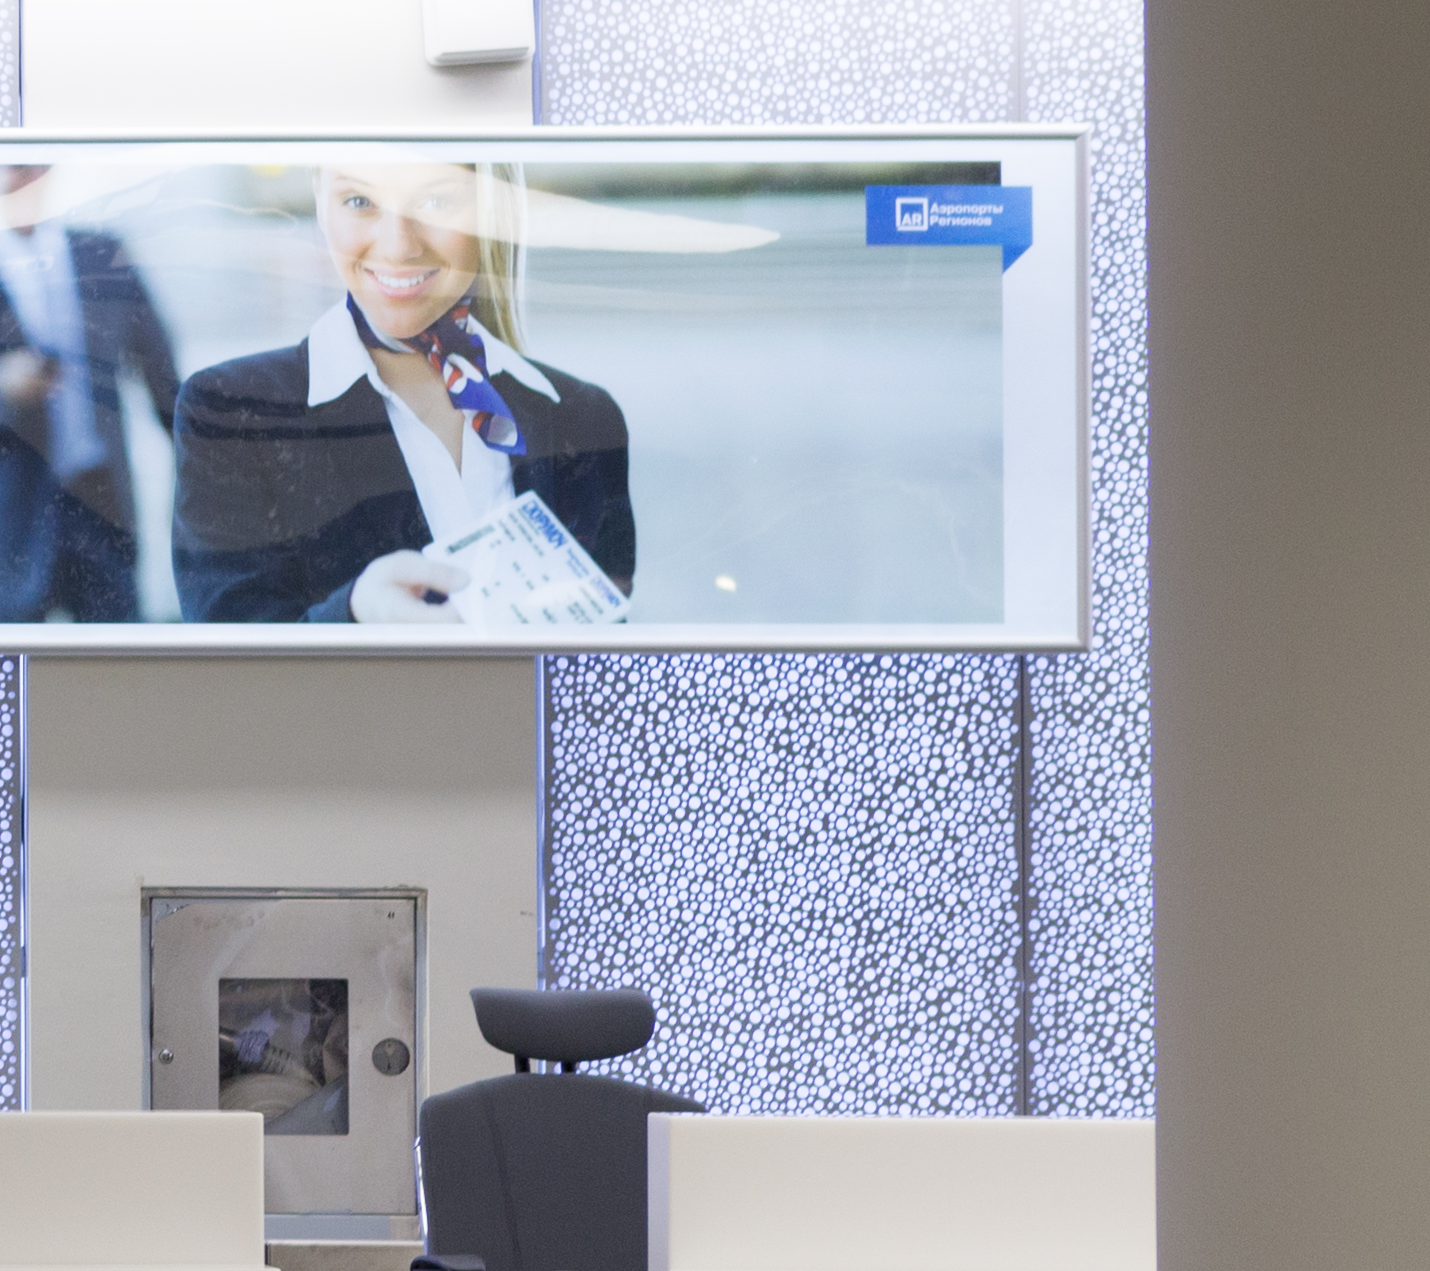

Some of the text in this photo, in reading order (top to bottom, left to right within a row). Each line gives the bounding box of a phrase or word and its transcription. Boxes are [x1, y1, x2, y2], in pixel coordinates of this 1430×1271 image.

[929, 202, 1003, 216] Аэропорты
[901, 213, 922, 226] AR
[929, 215, 992, 227] Регионов
